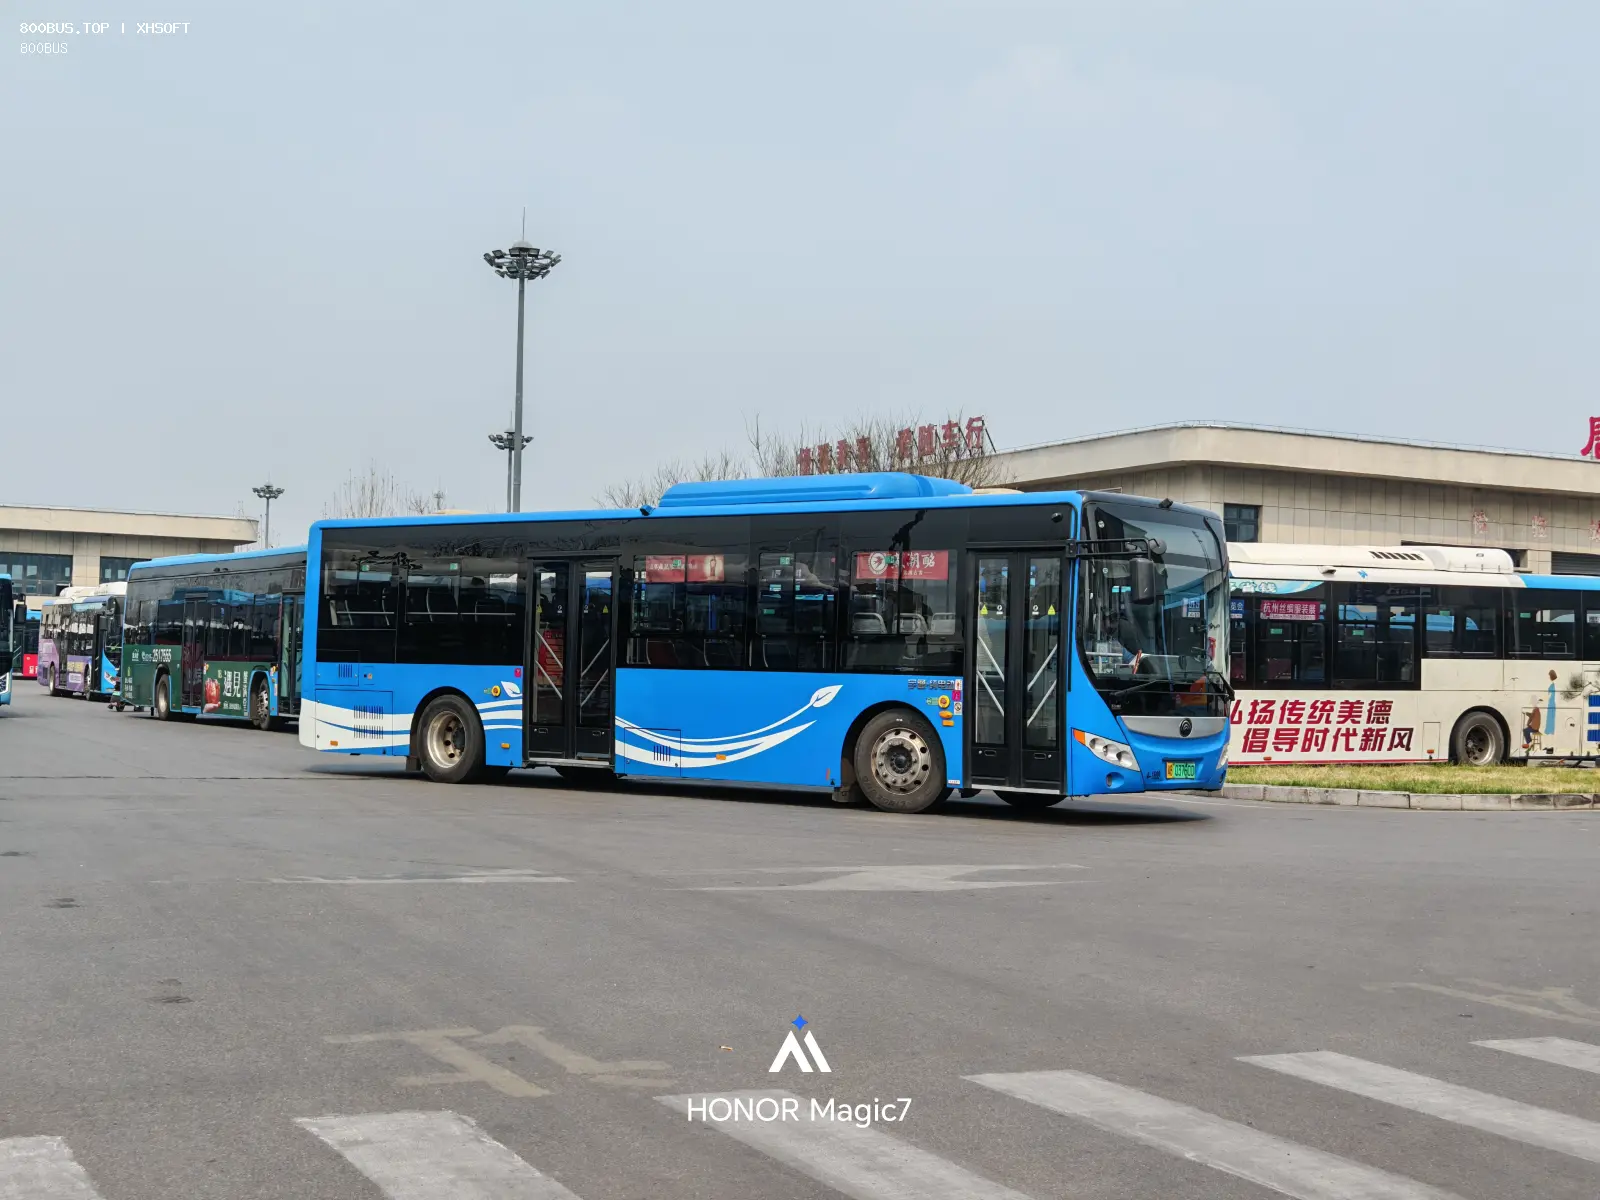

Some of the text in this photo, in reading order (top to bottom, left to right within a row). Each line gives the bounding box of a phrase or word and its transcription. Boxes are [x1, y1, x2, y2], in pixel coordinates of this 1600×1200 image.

[1242, 727, 1414, 753] 倡导时代新风
